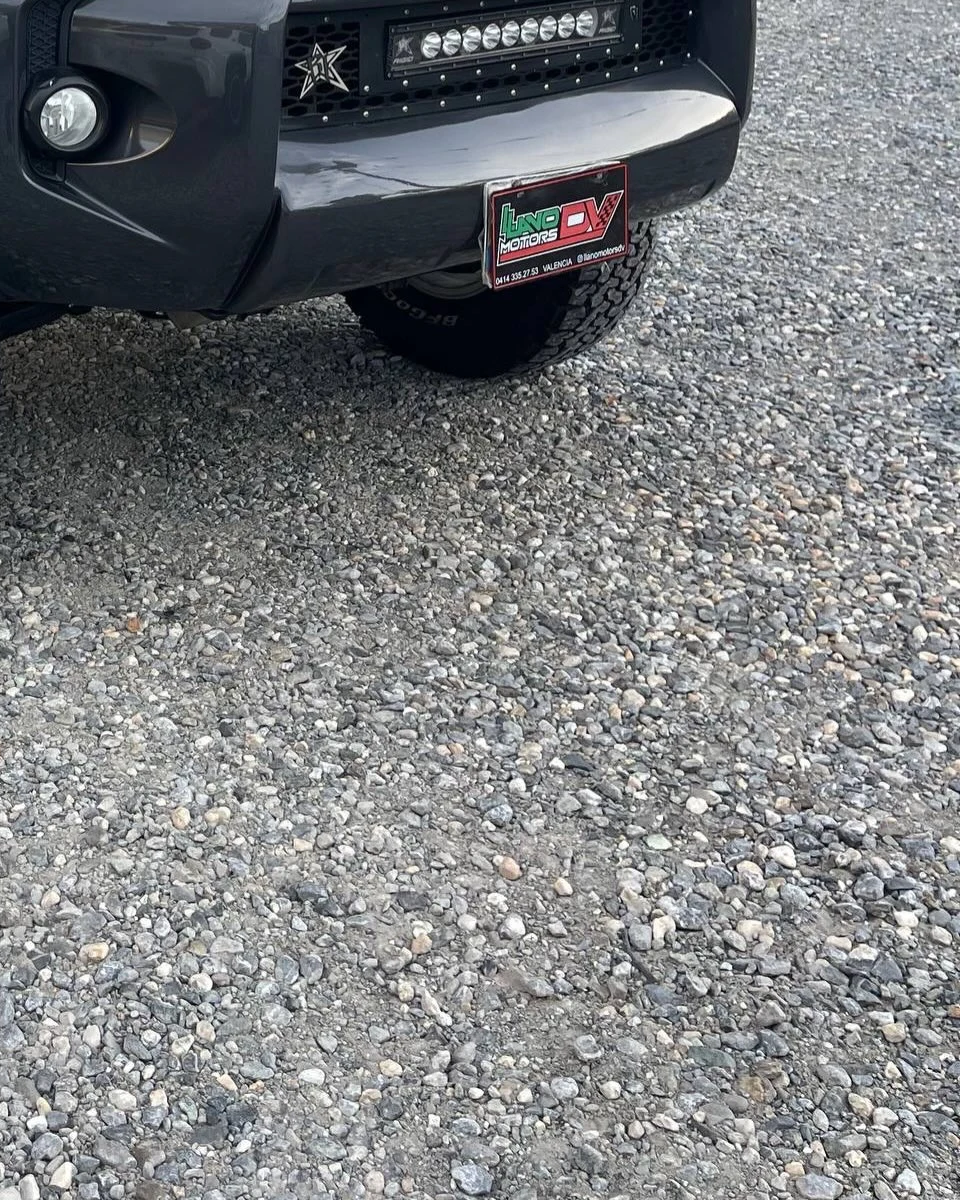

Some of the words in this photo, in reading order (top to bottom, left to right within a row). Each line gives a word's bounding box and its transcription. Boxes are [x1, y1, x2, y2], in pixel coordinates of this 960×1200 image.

[500, 229, 558, 254] MOTORS
[496, 275, 510, 286] 0414
[542, 258, 573, 272] VALENCIA
